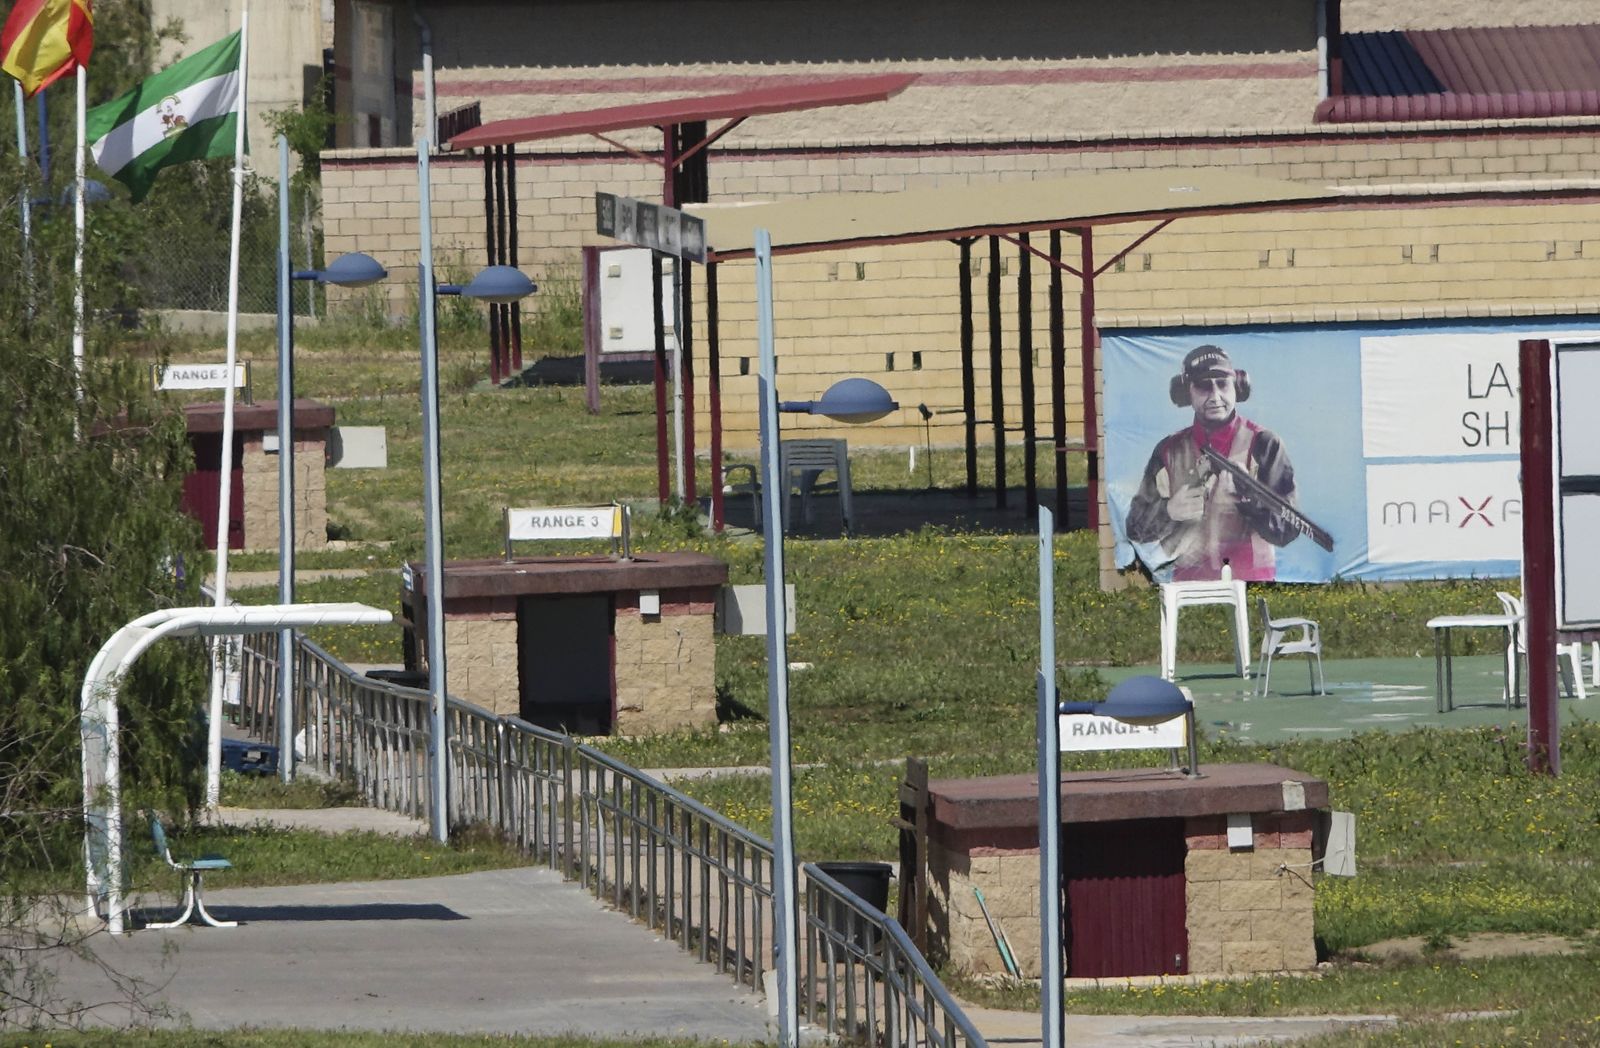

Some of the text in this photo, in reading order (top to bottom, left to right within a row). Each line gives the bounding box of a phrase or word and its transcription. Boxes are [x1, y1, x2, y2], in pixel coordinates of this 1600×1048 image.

[172, 369, 218, 381] RANGE
[1467, 362, 1520, 400] LA
[1461, 411, 1511, 448] SH
[531, 514, 600, 529] RANGE 3
[1072, 720, 1141, 737] RANGE
